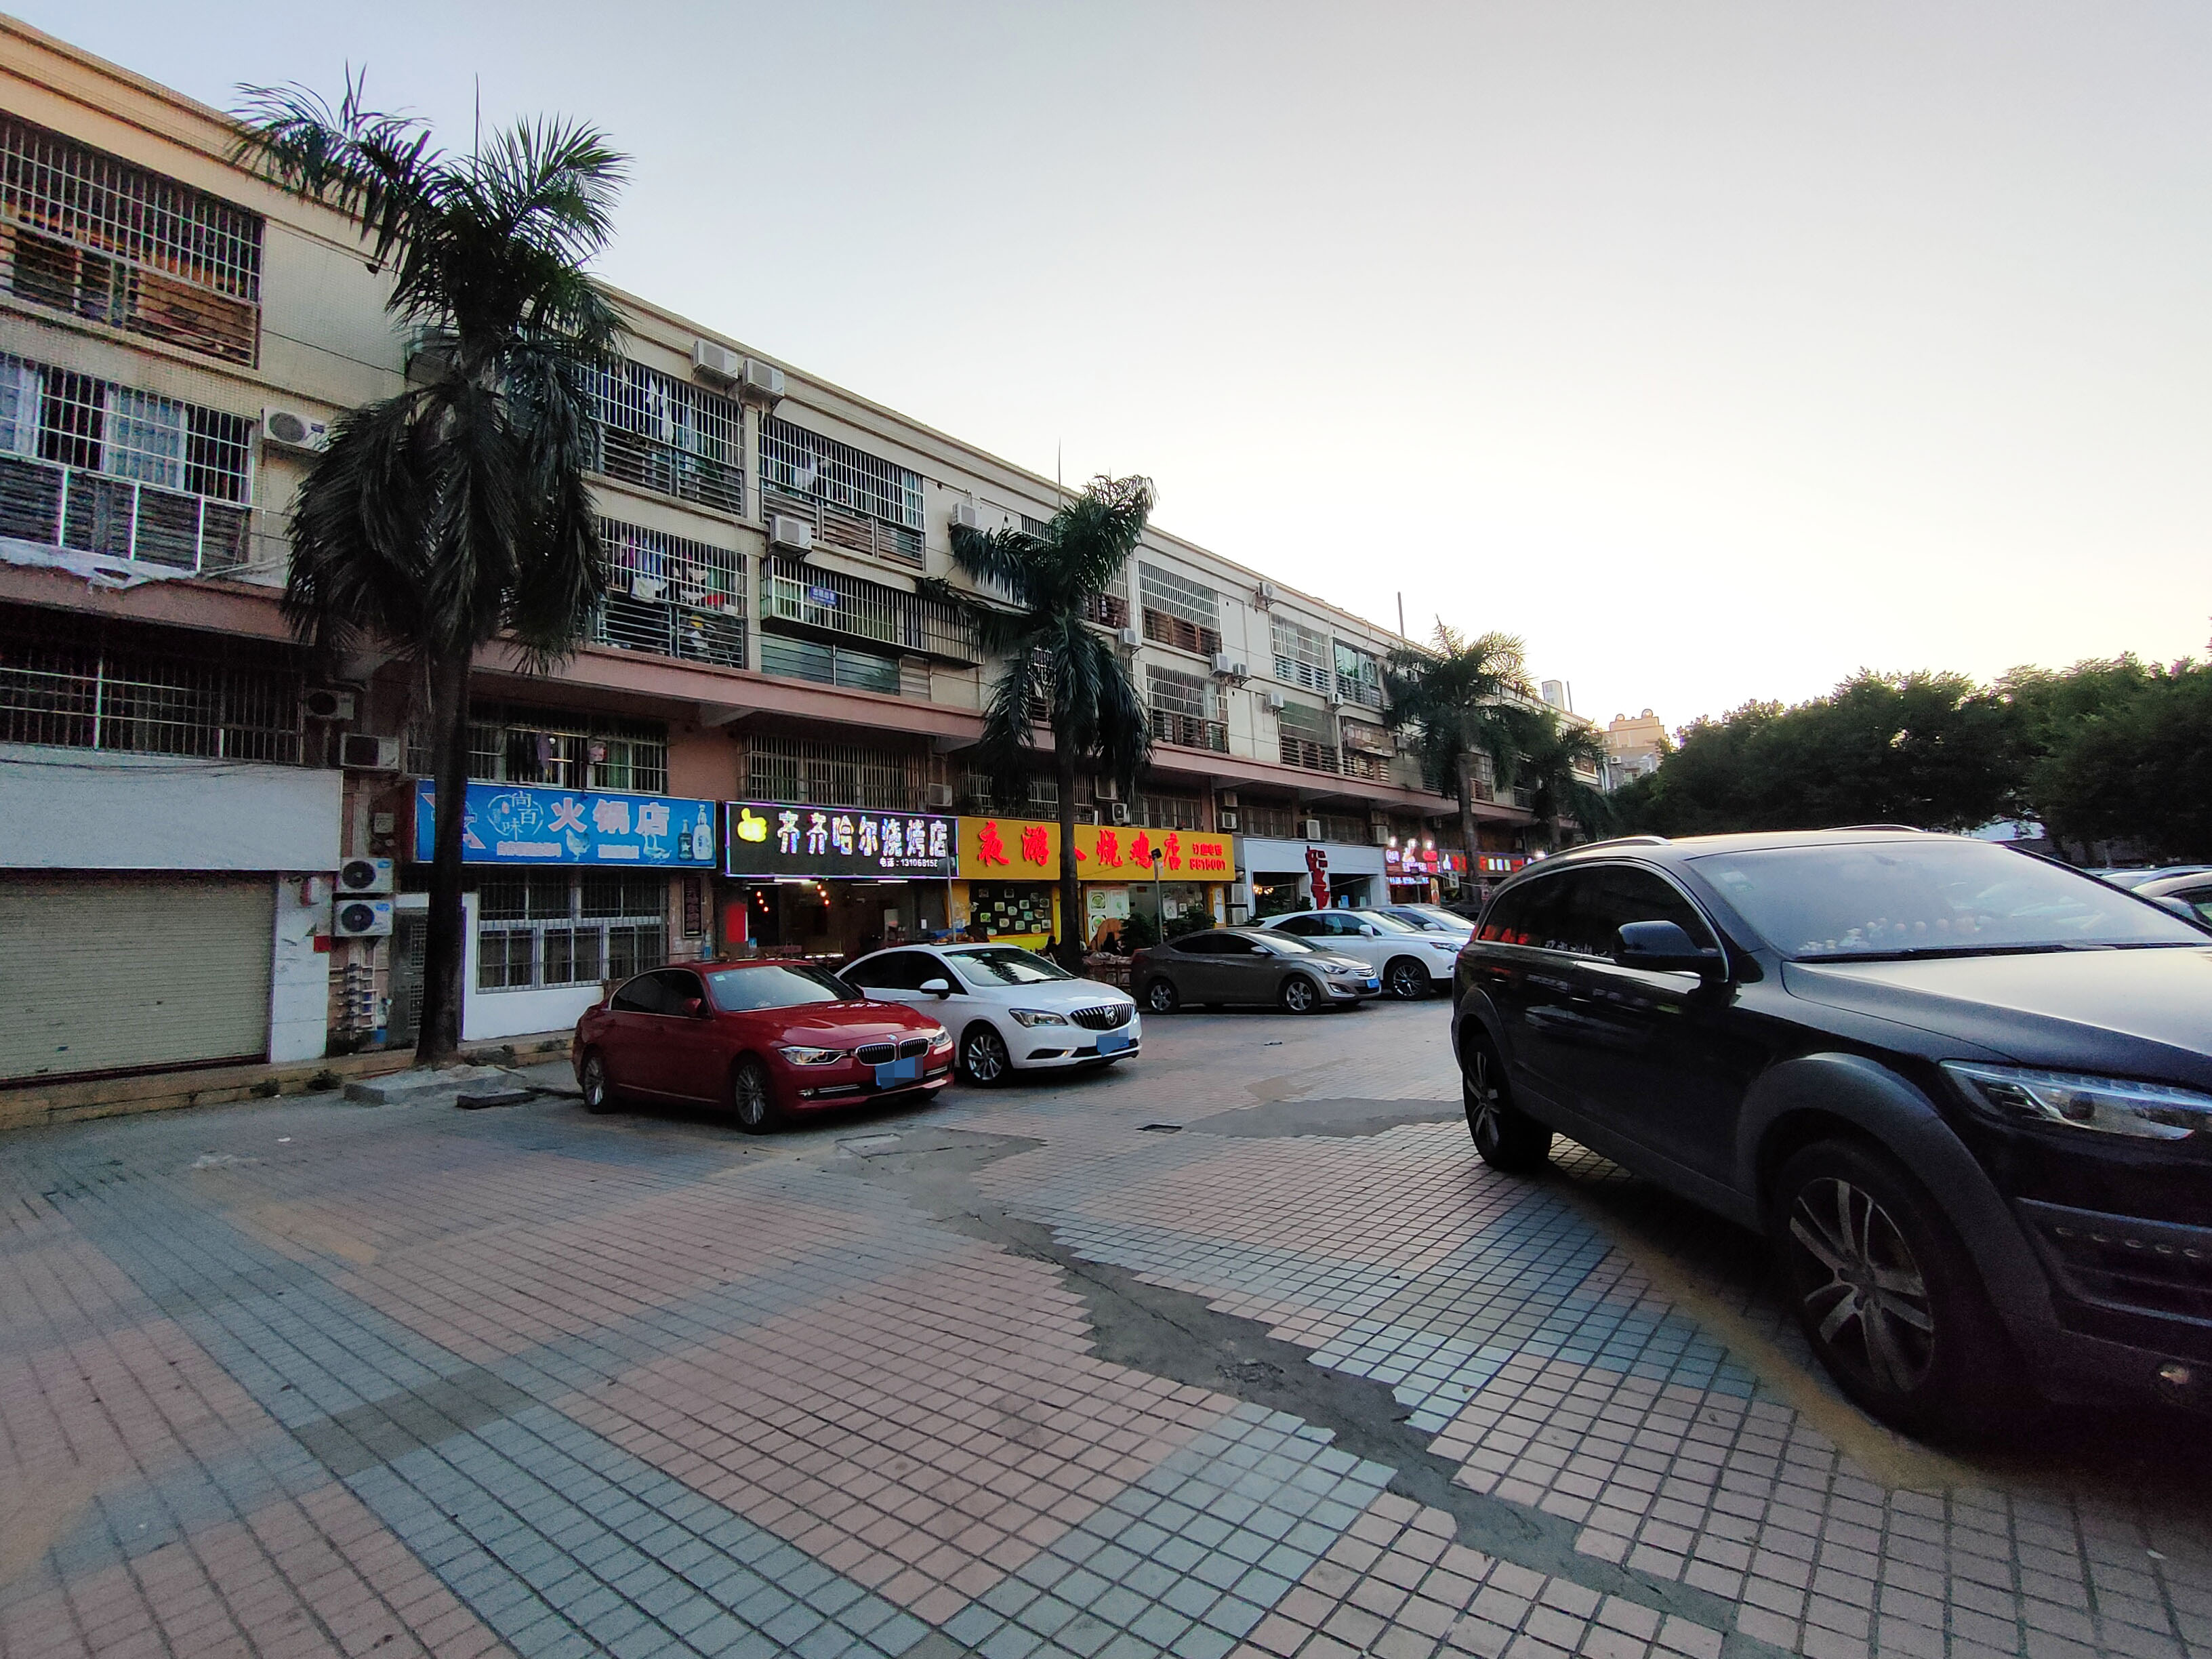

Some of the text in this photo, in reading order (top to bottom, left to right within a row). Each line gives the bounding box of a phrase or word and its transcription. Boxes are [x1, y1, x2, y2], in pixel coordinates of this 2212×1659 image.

[548, 797, 670, 836] 火锅店
[777, 811, 948, 857] 齐齐哈尔烧烤店
